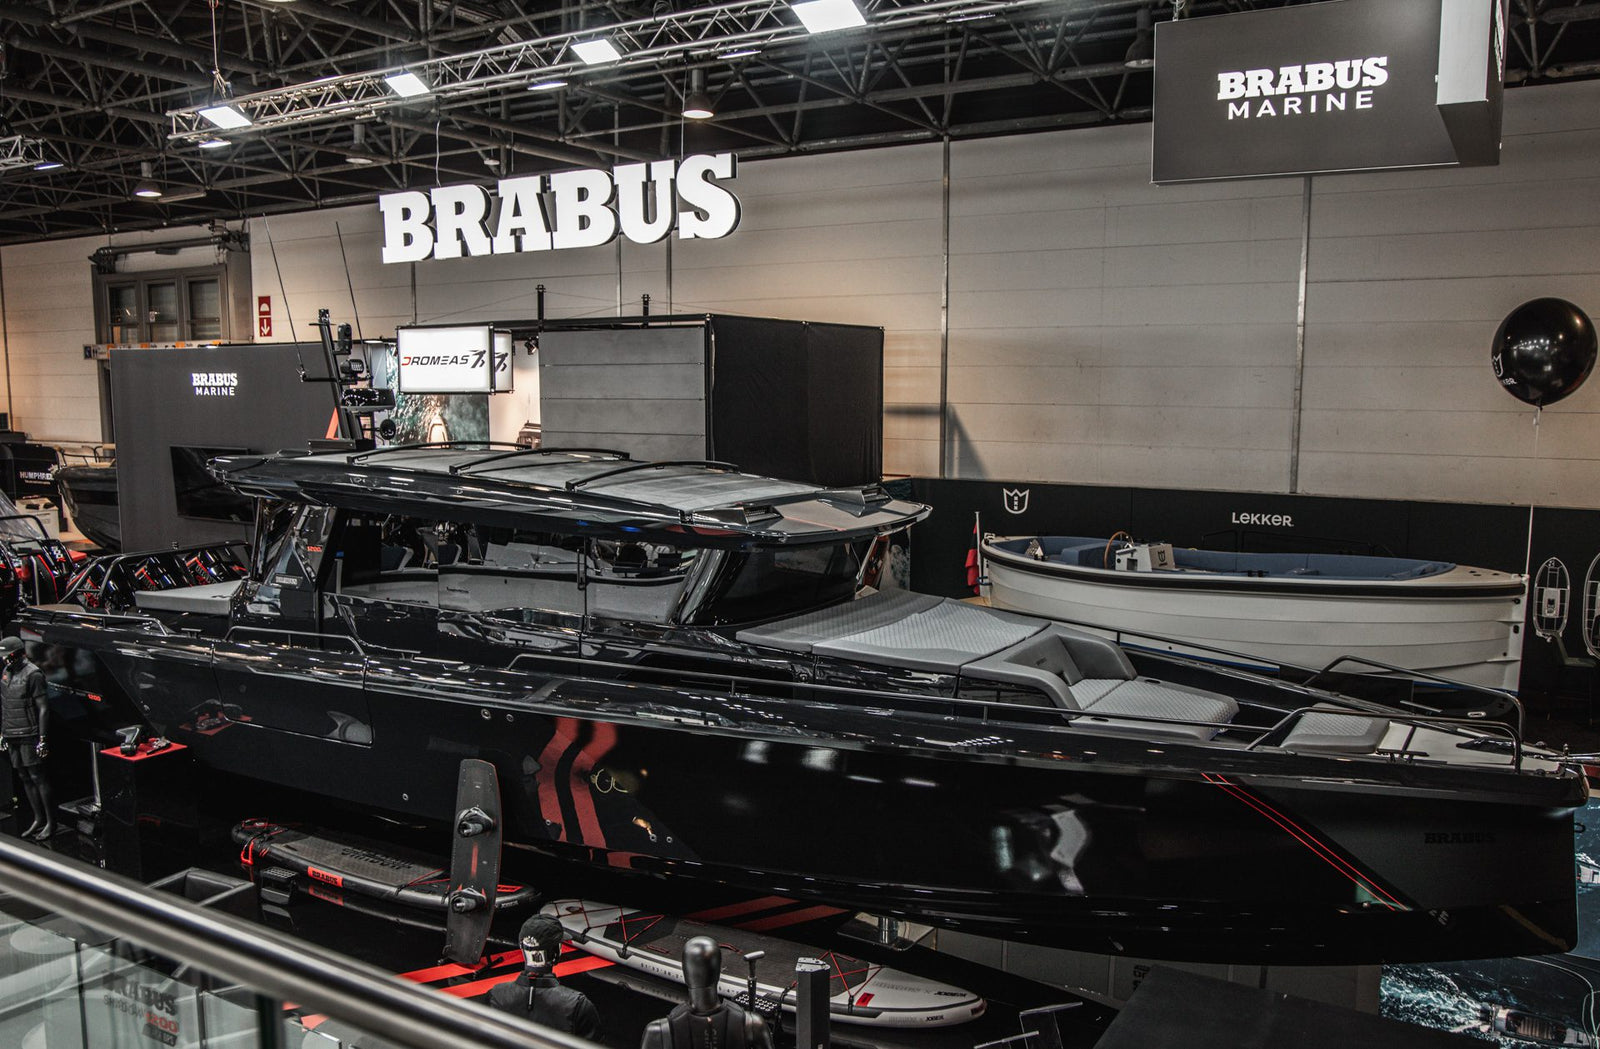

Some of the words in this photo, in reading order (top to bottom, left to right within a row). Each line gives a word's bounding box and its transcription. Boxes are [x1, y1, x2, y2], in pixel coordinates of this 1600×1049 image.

[1217, 56, 1388, 100] BRABUS
[1228, 90, 1374, 120] MARINE
[380, 153, 742, 264] BRABUS
[402, 355, 469, 366] DROMEAS
[192, 373, 238, 387] BRABUS
[195, 387, 236, 396] MARINE
[1424, 832, 1496, 843] BRABUS
